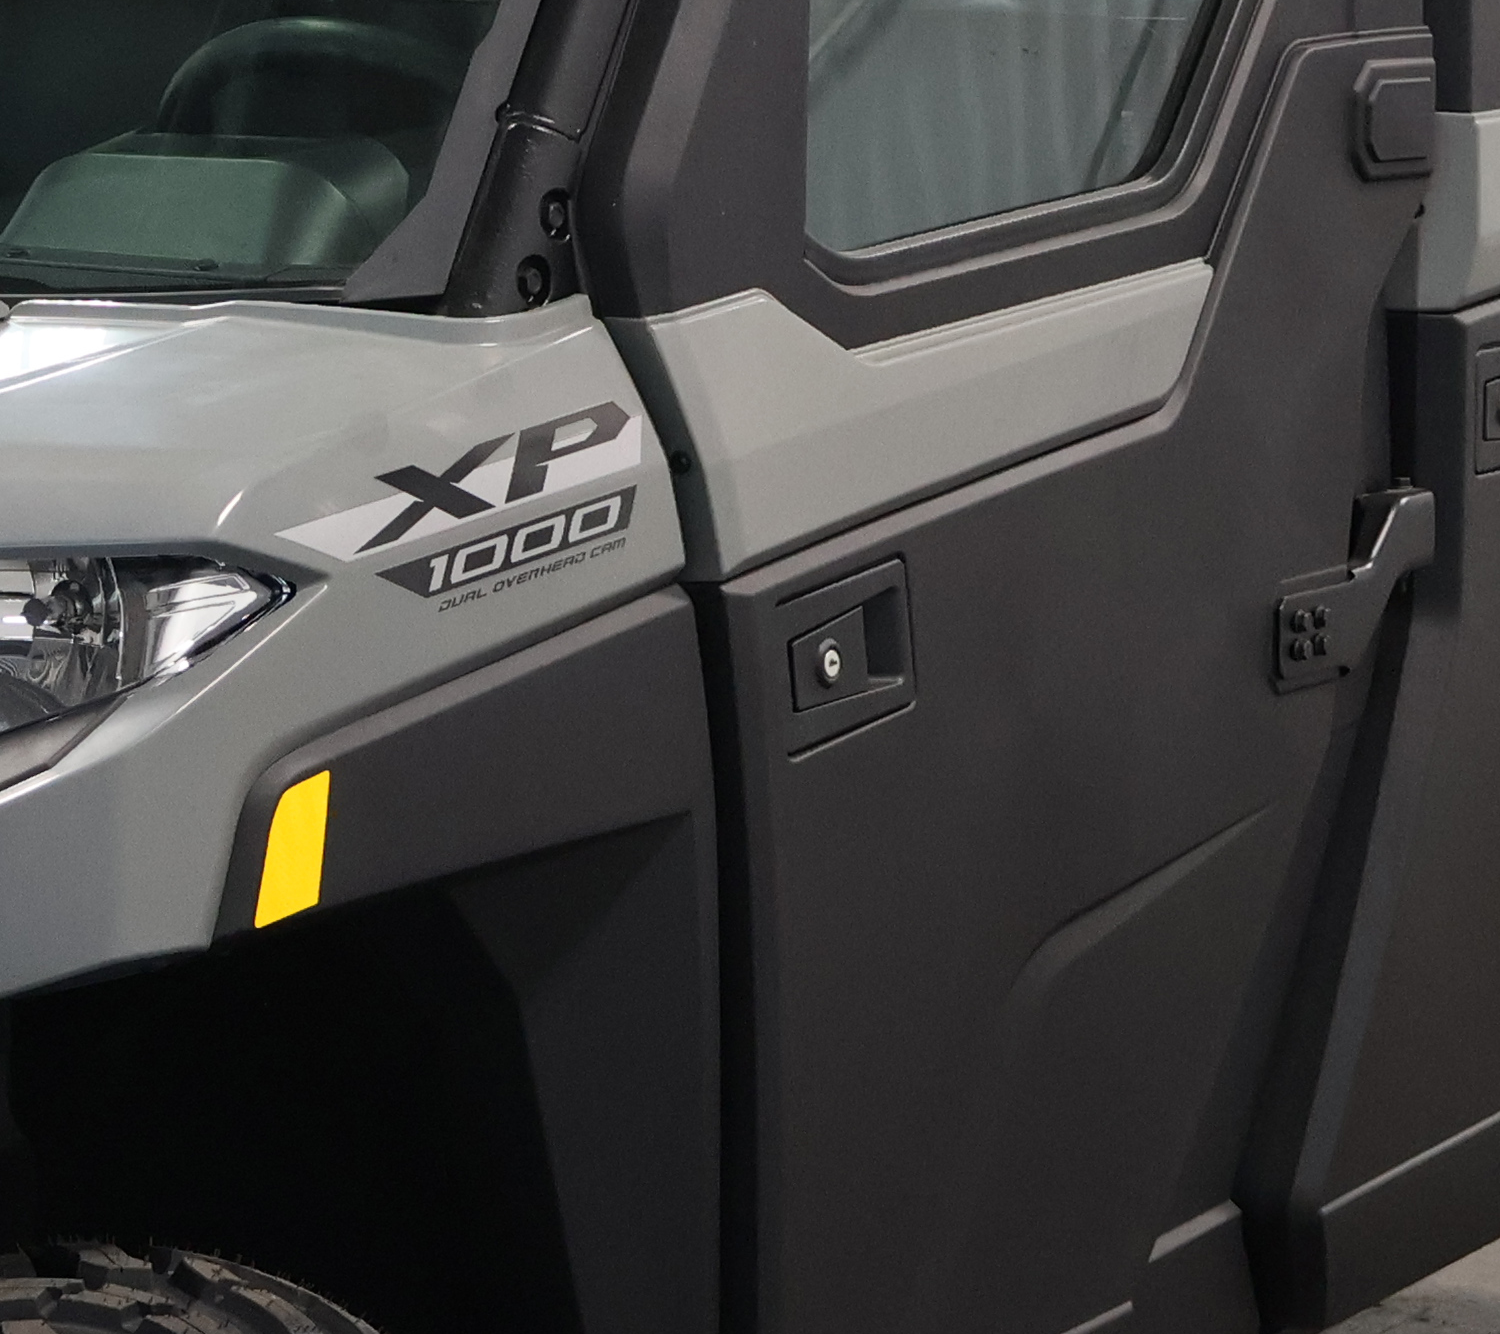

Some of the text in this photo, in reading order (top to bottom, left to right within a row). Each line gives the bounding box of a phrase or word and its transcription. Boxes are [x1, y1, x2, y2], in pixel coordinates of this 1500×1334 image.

[353, 400, 631, 555] XP
[429, 496, 622, 593] 1000
[437, 536, 627, 613] DUAL OVERHEAD CAM
